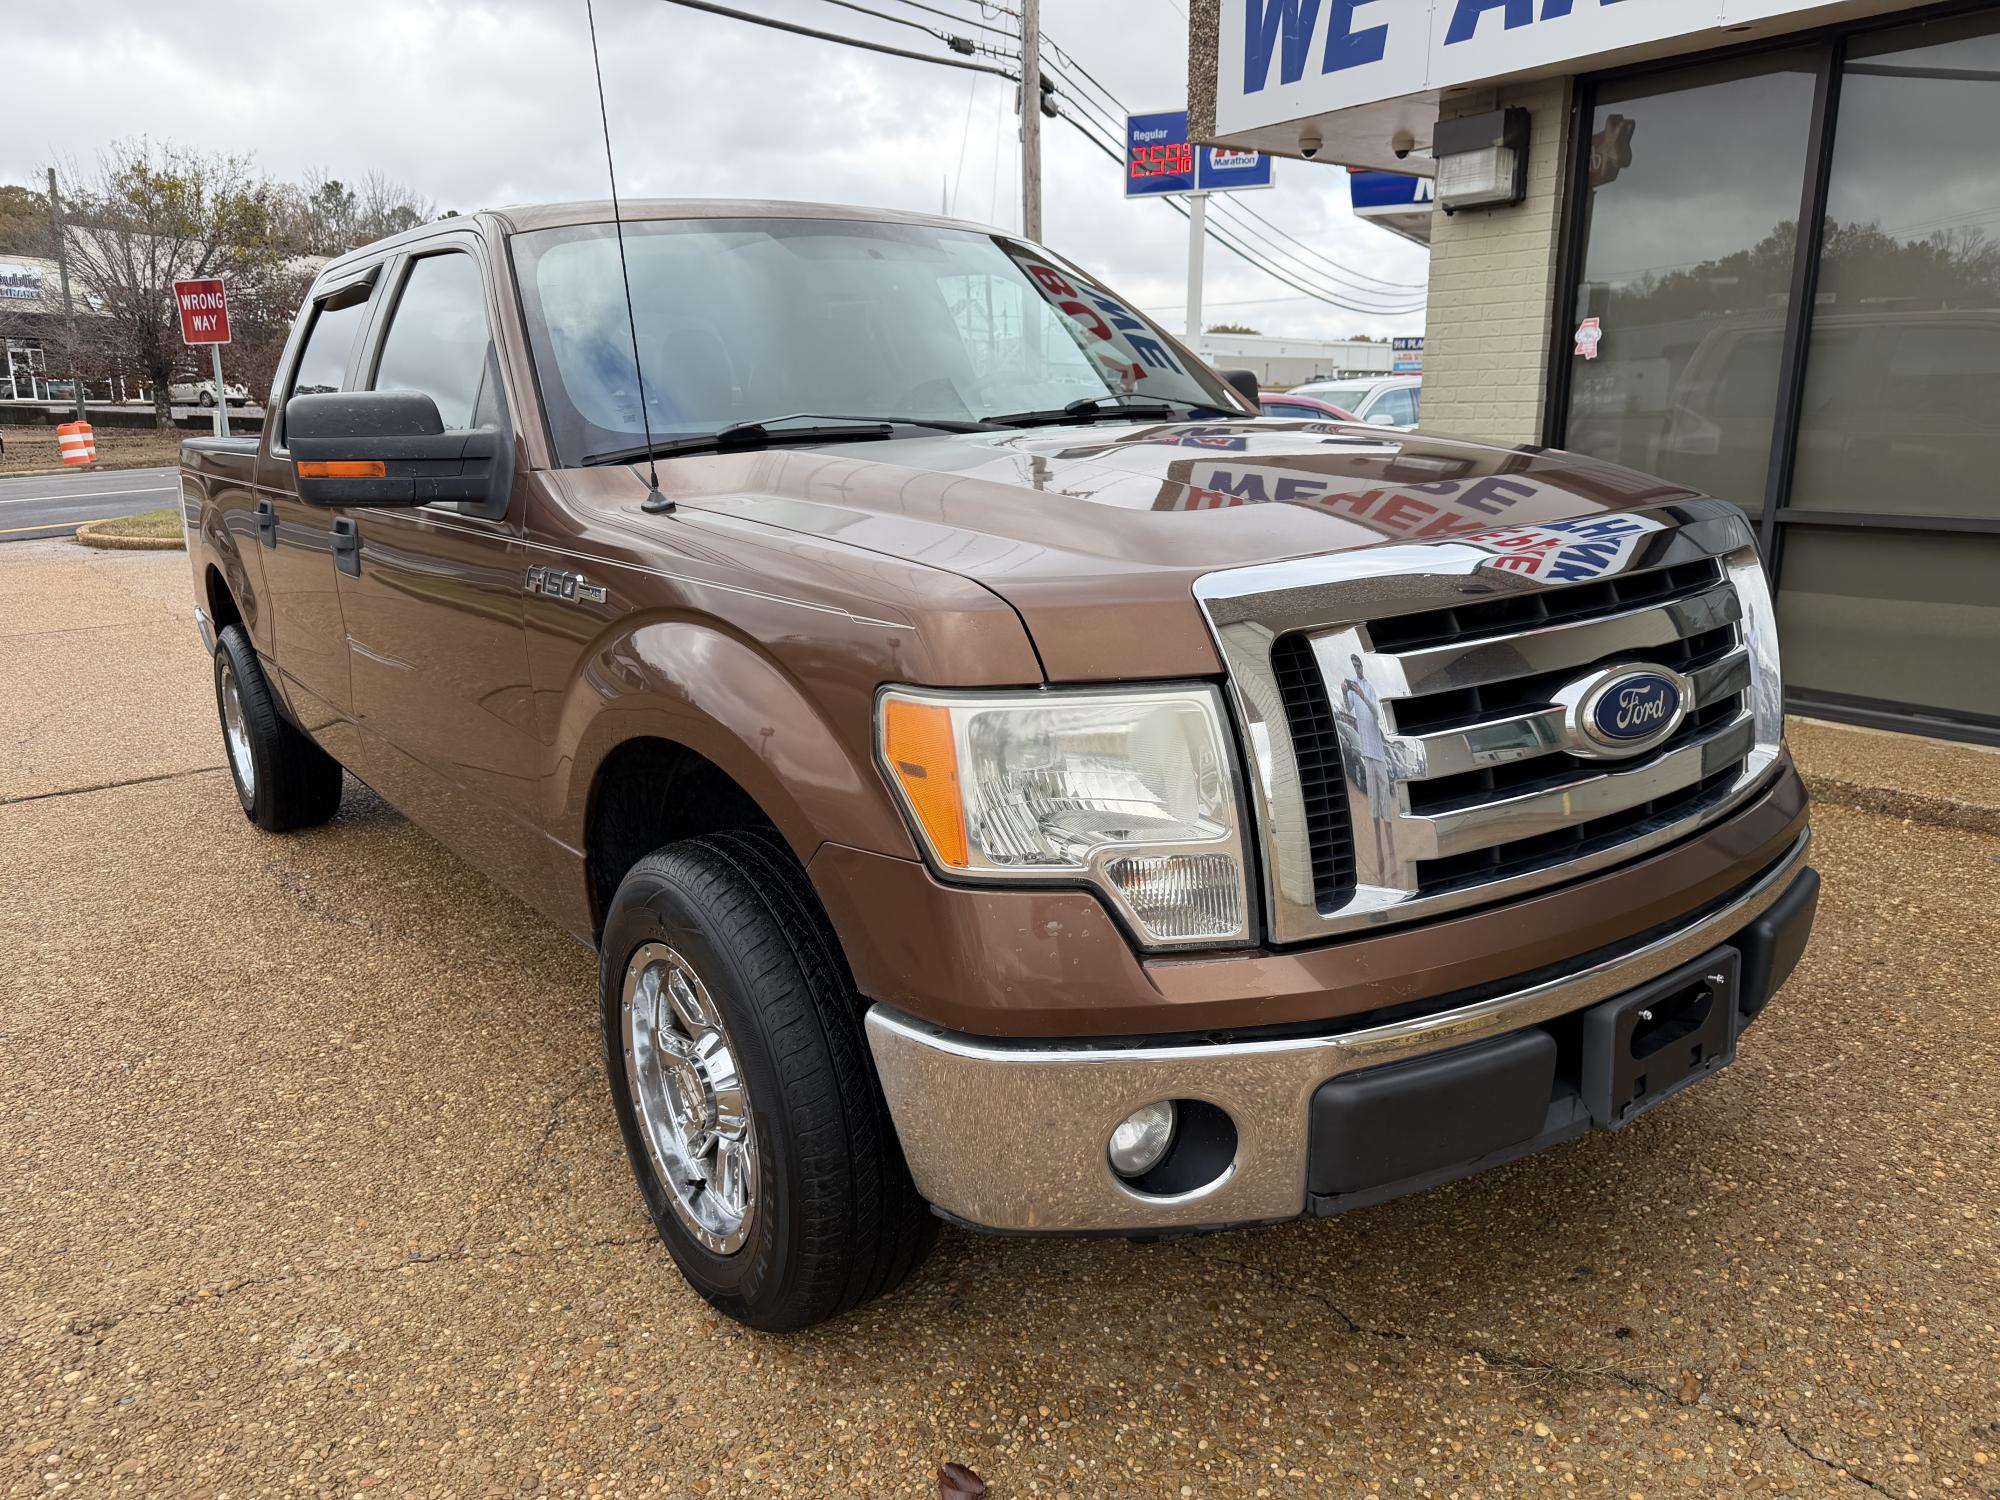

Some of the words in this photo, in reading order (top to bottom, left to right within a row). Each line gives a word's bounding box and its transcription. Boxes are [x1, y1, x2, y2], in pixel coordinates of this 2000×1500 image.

[1133, 129, 1168, 141] Regular
[1214, 156, 1255, 166] Marathon
[181, 293, 223, 310] WRONG
[192, 315, 217, 331] WAY
[1616, 685, 1666, 729] Ford
